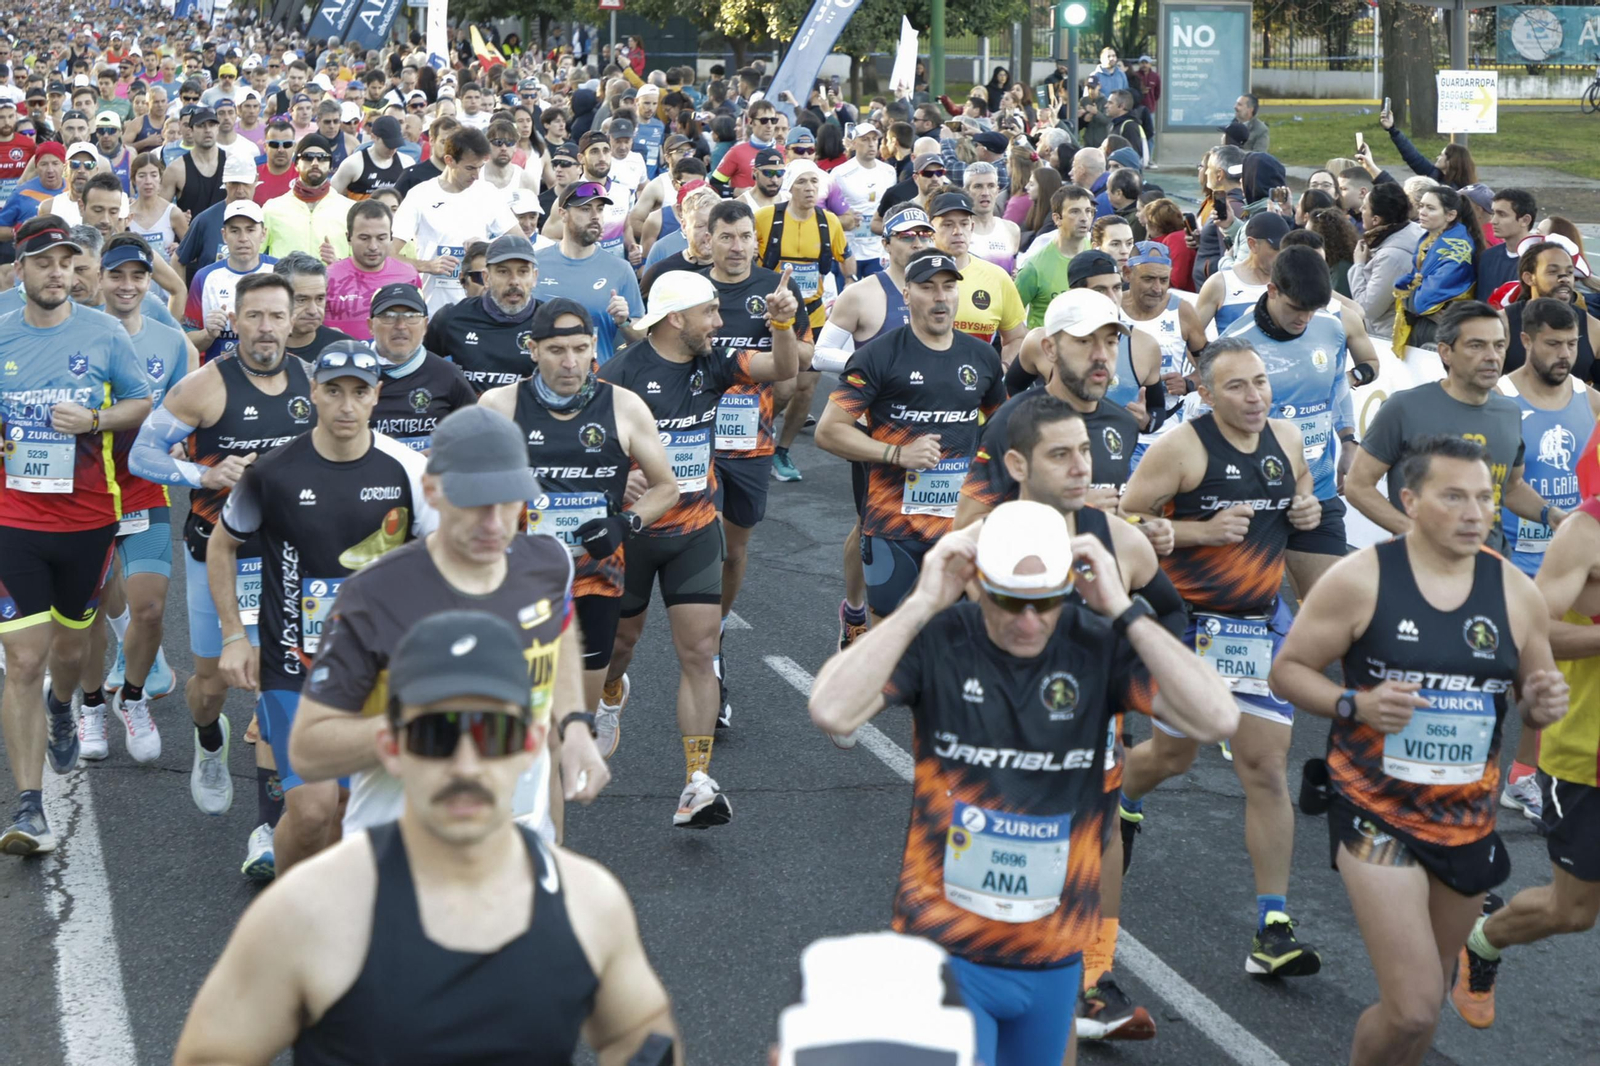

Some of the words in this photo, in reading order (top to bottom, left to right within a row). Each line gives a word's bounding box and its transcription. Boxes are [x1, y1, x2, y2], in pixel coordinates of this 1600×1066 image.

[1172, 25, 1216, 47] NO
[1440, 77, 1495, 88] GUARDARROPA
[1440, 90, 1474, 100] BAGGAGE
[1440, 101, 1469, 111] SERVICE
[721, 396, 754, 406] ZURICH
[1300, 403, 1326, 415] ZURICH
[653, 407, 716, 429] RTIBLES
[721, 413, 739, 421] 7017
[1300, 422, 1316, 431] 5794
[27, 430, 67, 441] ZURICH
[675, 433, 706, 444] ZURICH
[27, 449, 48, 459] 5239
[674, 453, 693, 463] 6884
[23, 462, 50, 476] ANT
[930, 480, 950, 489] 5376
[360, 486, 402, 502] GORDILLO
[554, 497, 598, 507] ZURICH
[555, 517, 579, 527] 5609
[1226, 623, 1267, 636] ZURICH
[1225, 645, 1248, 656] 6043
[1216, 658, 1255, 676] FRAN
[1429, 696, 1484, 711] ZURICH
[1426, 724, 1457, 738] 5654
[1404, 739, 1474, 762] VICTOR
[992, 817, 1060, 838] ZURICH
[992, 850, 1027, 868] 5696
[981, 870, 1029, 896] ANA
